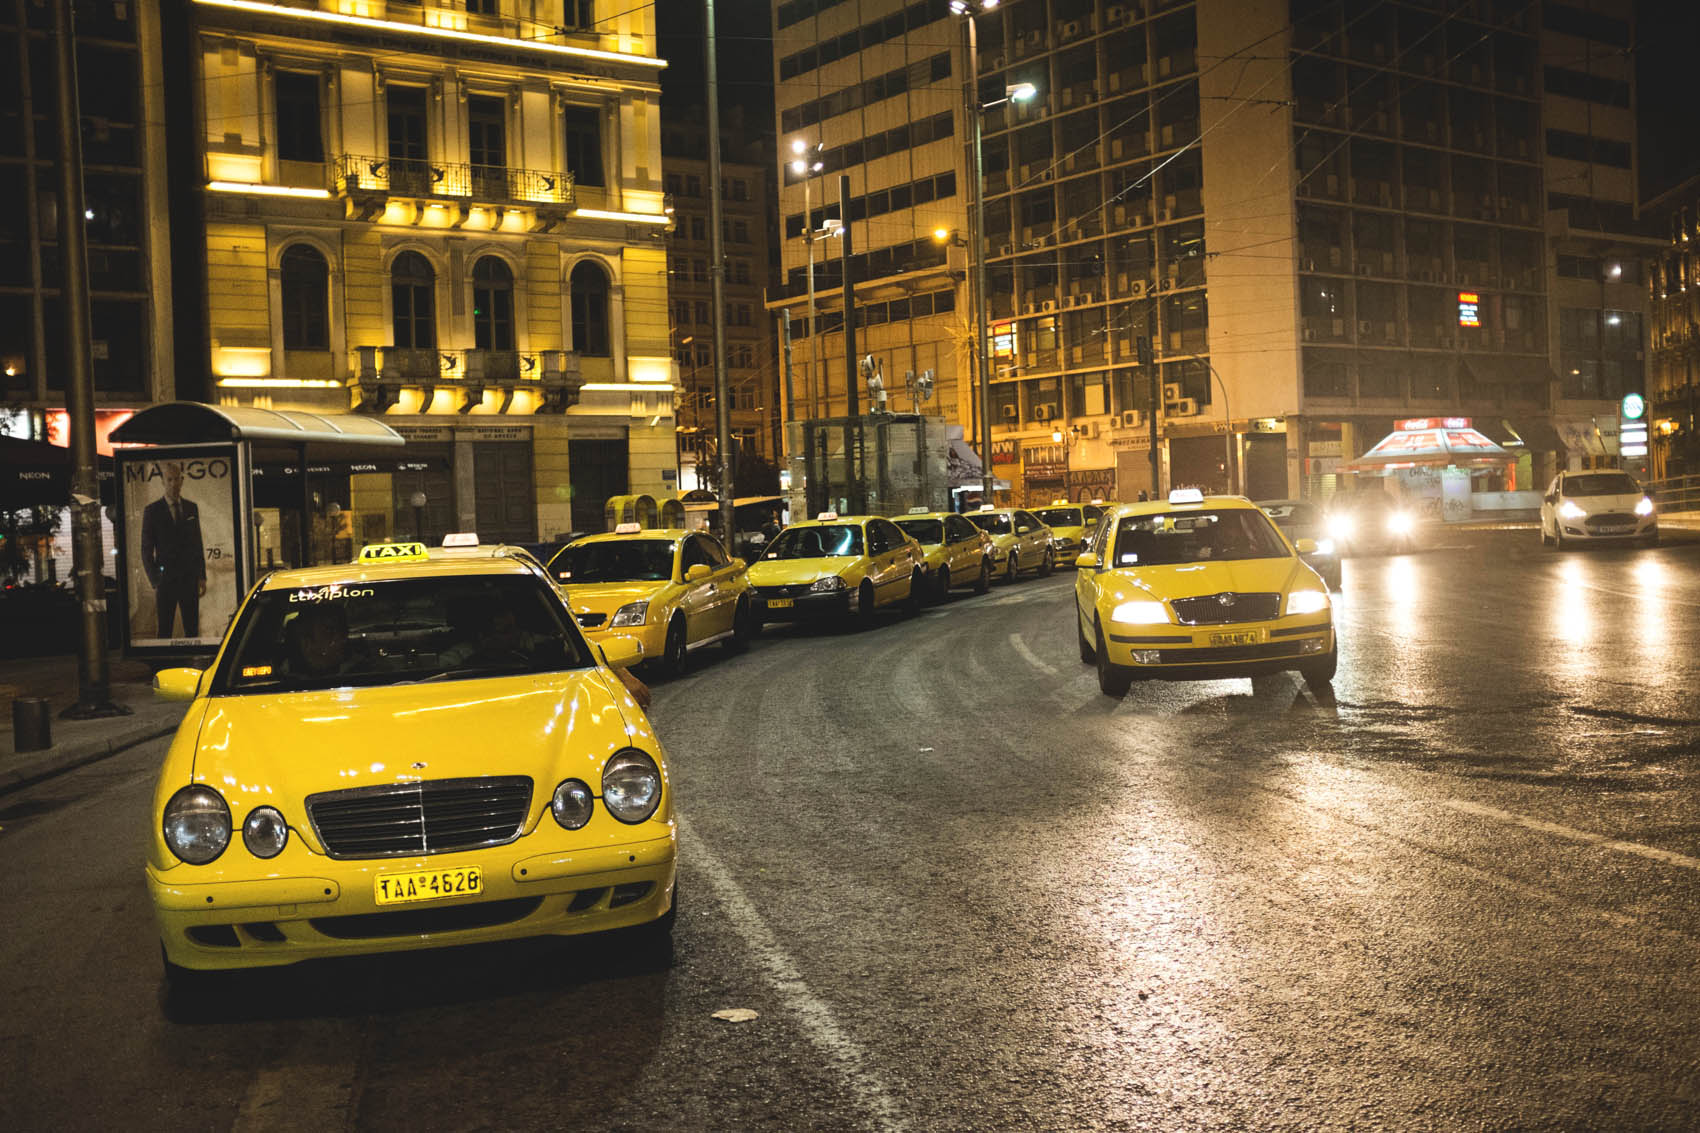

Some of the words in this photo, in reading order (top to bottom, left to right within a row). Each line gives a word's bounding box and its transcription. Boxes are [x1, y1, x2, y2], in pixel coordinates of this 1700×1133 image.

[19, 471, 51, 480] NEON
[206, 547, 222, 560] 79
[366, 544, 422, 558] TAXI
